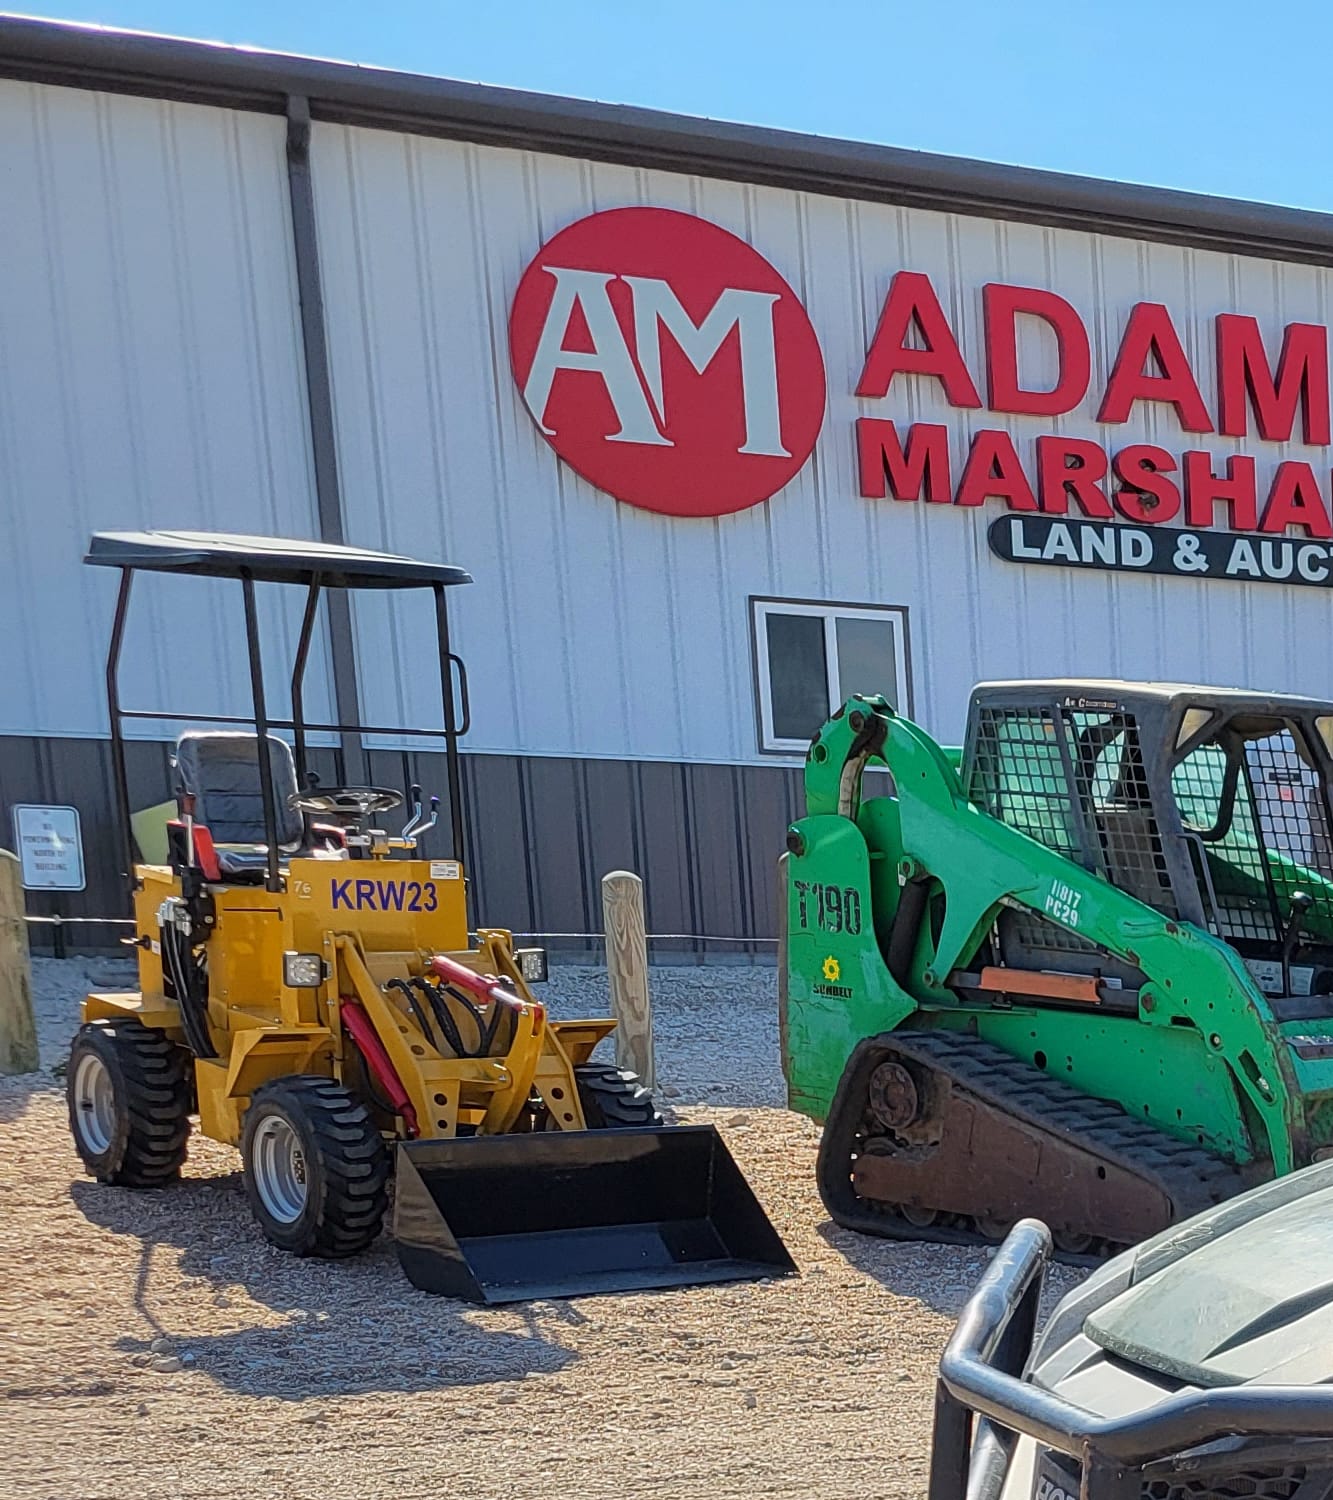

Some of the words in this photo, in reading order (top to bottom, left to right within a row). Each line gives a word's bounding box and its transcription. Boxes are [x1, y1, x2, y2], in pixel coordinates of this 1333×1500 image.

[524, 265, 792, 457] AM
[855, 270, 1332, 446] ADAM
[1010, 519, 1153, 567] LAND
[1173, 533, 1210, 573] &
[331, 878, 438, 912] KRW23
[793, 880, 862, 936] T190
[1045, 894, 1079, 928] PC29
